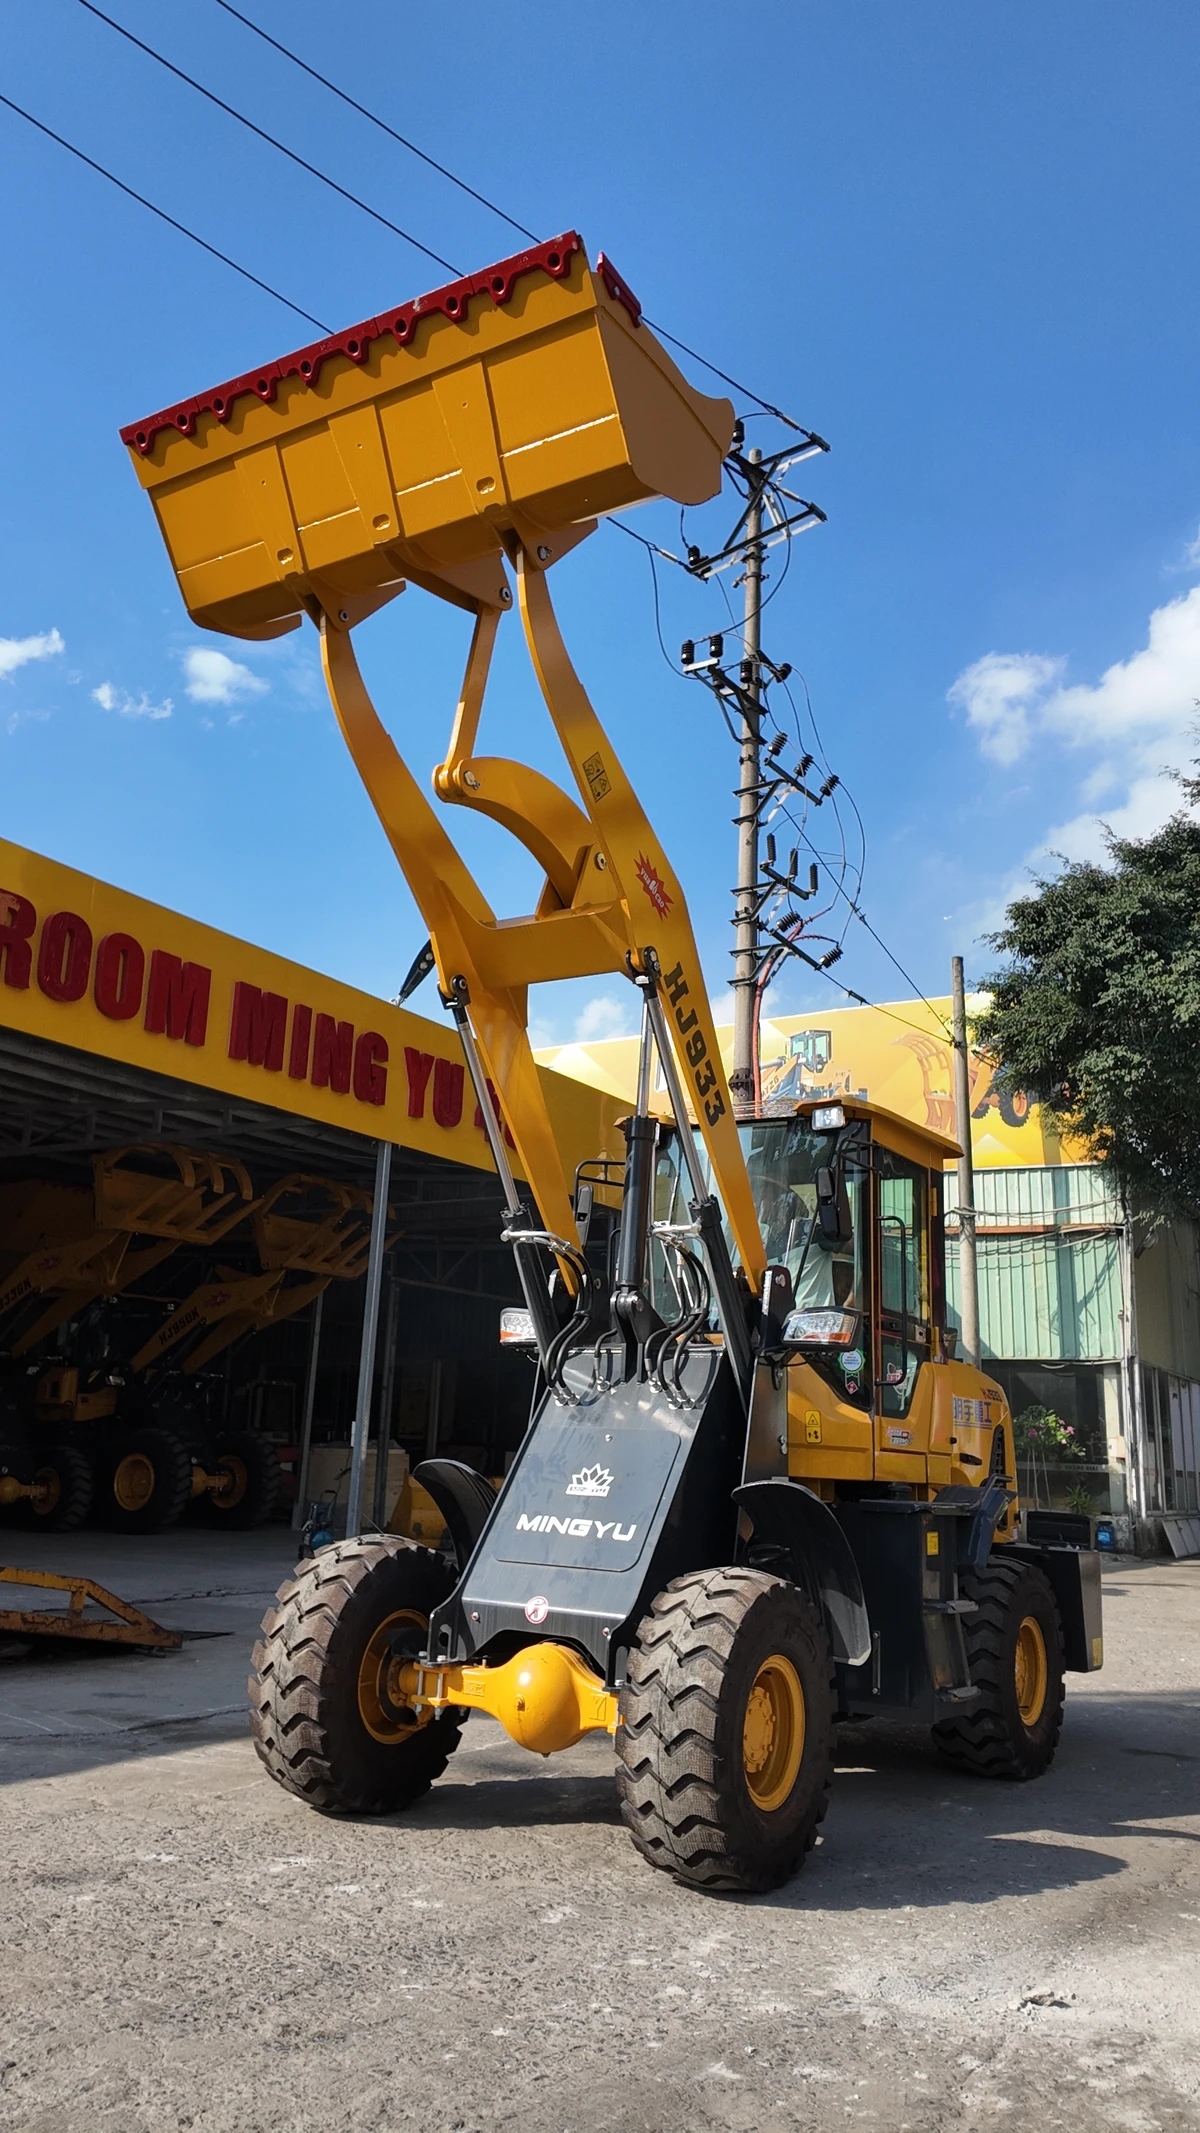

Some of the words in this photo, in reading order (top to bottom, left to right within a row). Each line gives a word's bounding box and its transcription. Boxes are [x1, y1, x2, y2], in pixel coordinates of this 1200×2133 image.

[0, 888, 211, 1046] ROOM
[228, 981, 389, 1106] MING
[404, 1046, 464, 1128] YU
[664, 962, 726, 1127] HJ933
[516, 1513, 637, 1542] MINGYU
